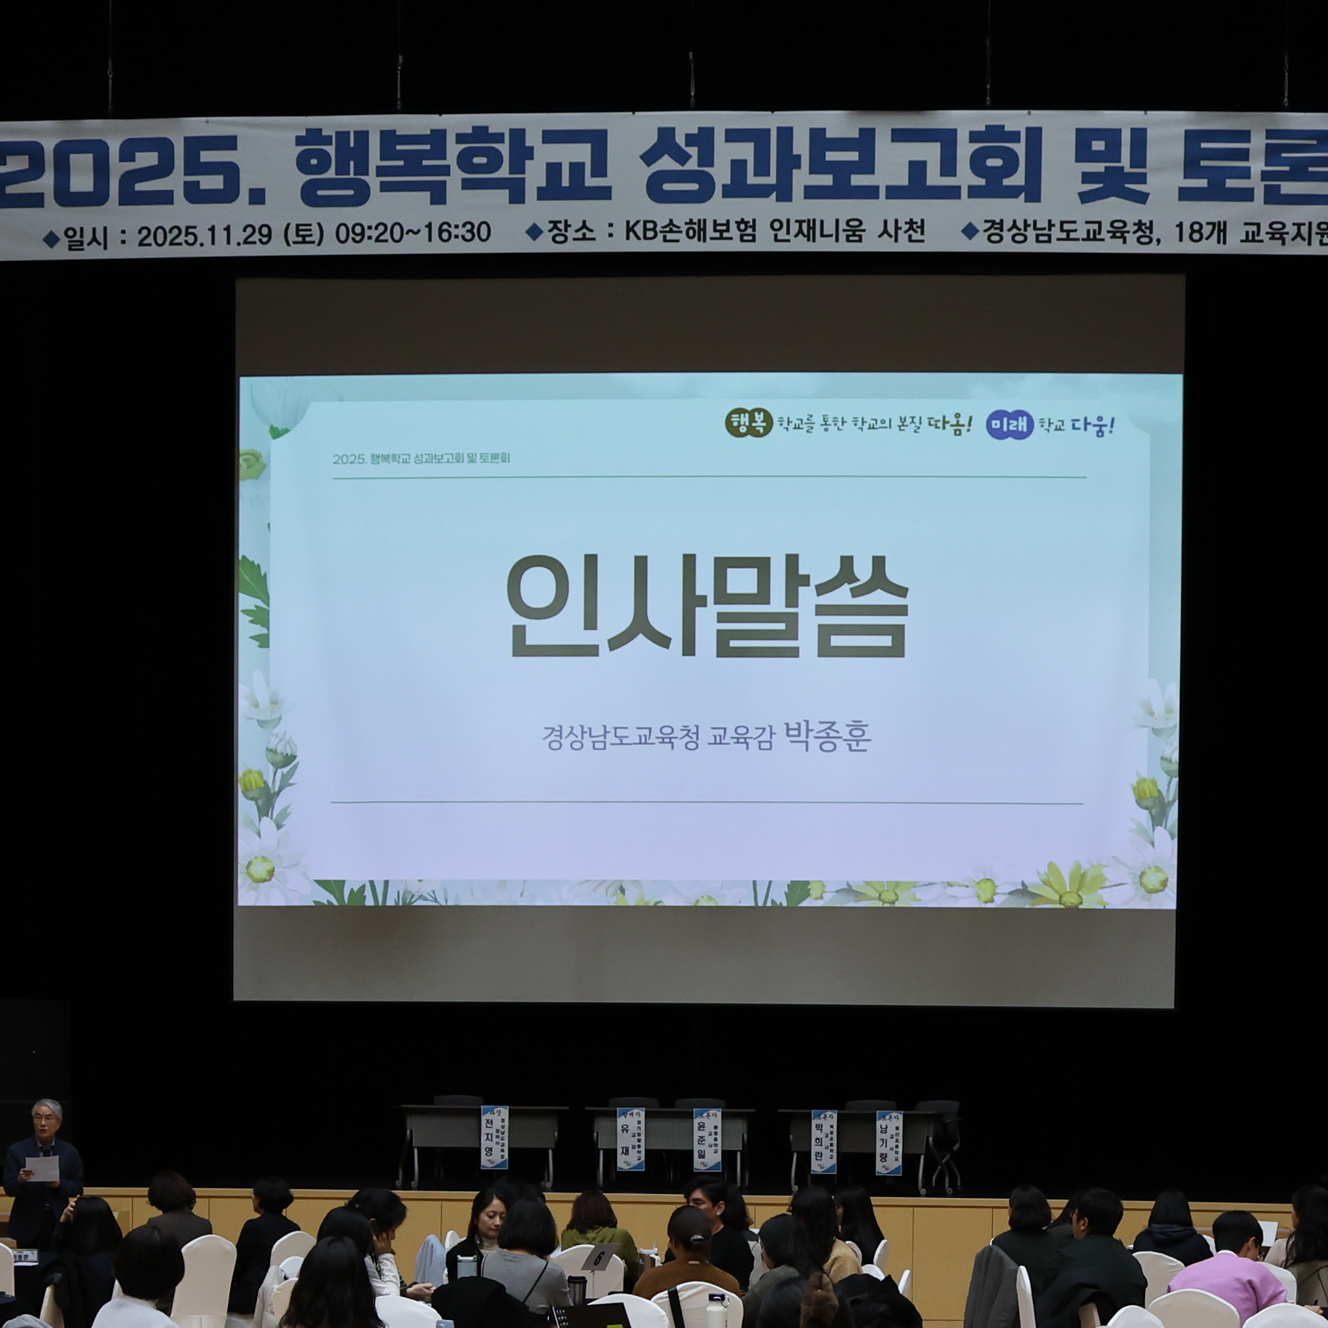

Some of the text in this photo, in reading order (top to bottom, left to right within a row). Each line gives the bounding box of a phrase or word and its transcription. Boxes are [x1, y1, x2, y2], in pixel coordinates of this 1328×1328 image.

[295, 126, 612, 207] 행복학교
[639, 125, 1042, 204] 성과보고회
[1075, 128, 1150, 205] 및
[64, 226, 107, 251] 일시
[138, 224, 272, 247] 2025.11.29
[284, 223, 323, 246] (토)
[336, 221, 491, 244] 09:20~16:30
[548, 219, 596, 244] 장소
[626, 218, 756, 242] KB손해보험
[770, 218, 866, 242] 인재니움
[878, 218, 924, 243] 사천
[983, 219, 1161, 245] 경상남도교육청,
[1176, 221, 1227, 245] 18개
[730, 411, 767, 434] 행복
[778, 414, 815, 433] 학교를
[821, 415, 847, 432] 통한
[853, 417, 891, 431] 학교의
[898, 416, 922, 433] 본질
[991, 415, 1114, 437] 미래 학교 다움!
[333, 454, 367, 464] 2025.
[371, 454, 410, 464] 행복학교
[414, 453, 464, 464] 성과보고회
[480, 453, 510, 463] 토론회
[507, 554, 909, 658] 인사말씀
[543, 720, 871, 752] 경상남도교육청 교육감 박종훈
[484, 1118, 493, 1157] 전지영
[697, 1121, 706, 1159] 윤준일
[594, 1251, 605, 1265] 6
